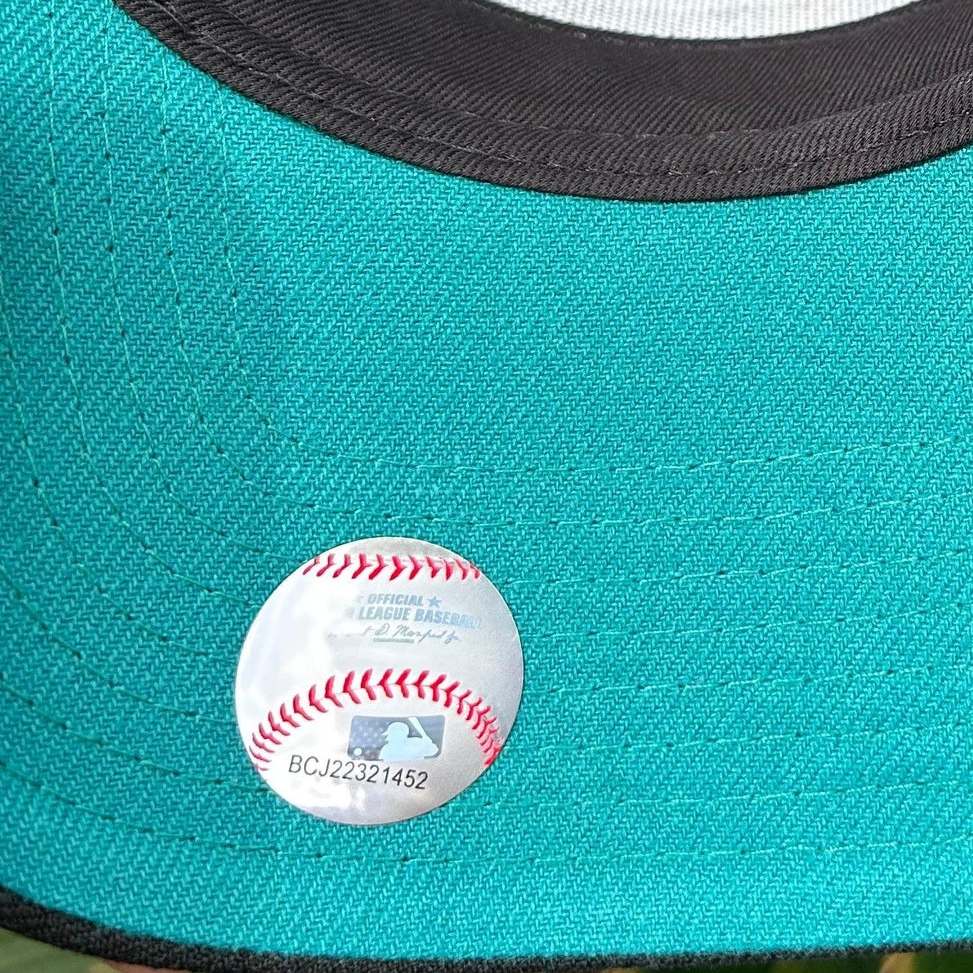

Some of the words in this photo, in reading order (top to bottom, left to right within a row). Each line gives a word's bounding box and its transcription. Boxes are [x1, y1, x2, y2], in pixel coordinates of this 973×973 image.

[367, 593, 424, 607] OFFICIAL
[358, 606, 411, 621] LEAGUE
[287, 754, 429, 790] BCJ22321452
